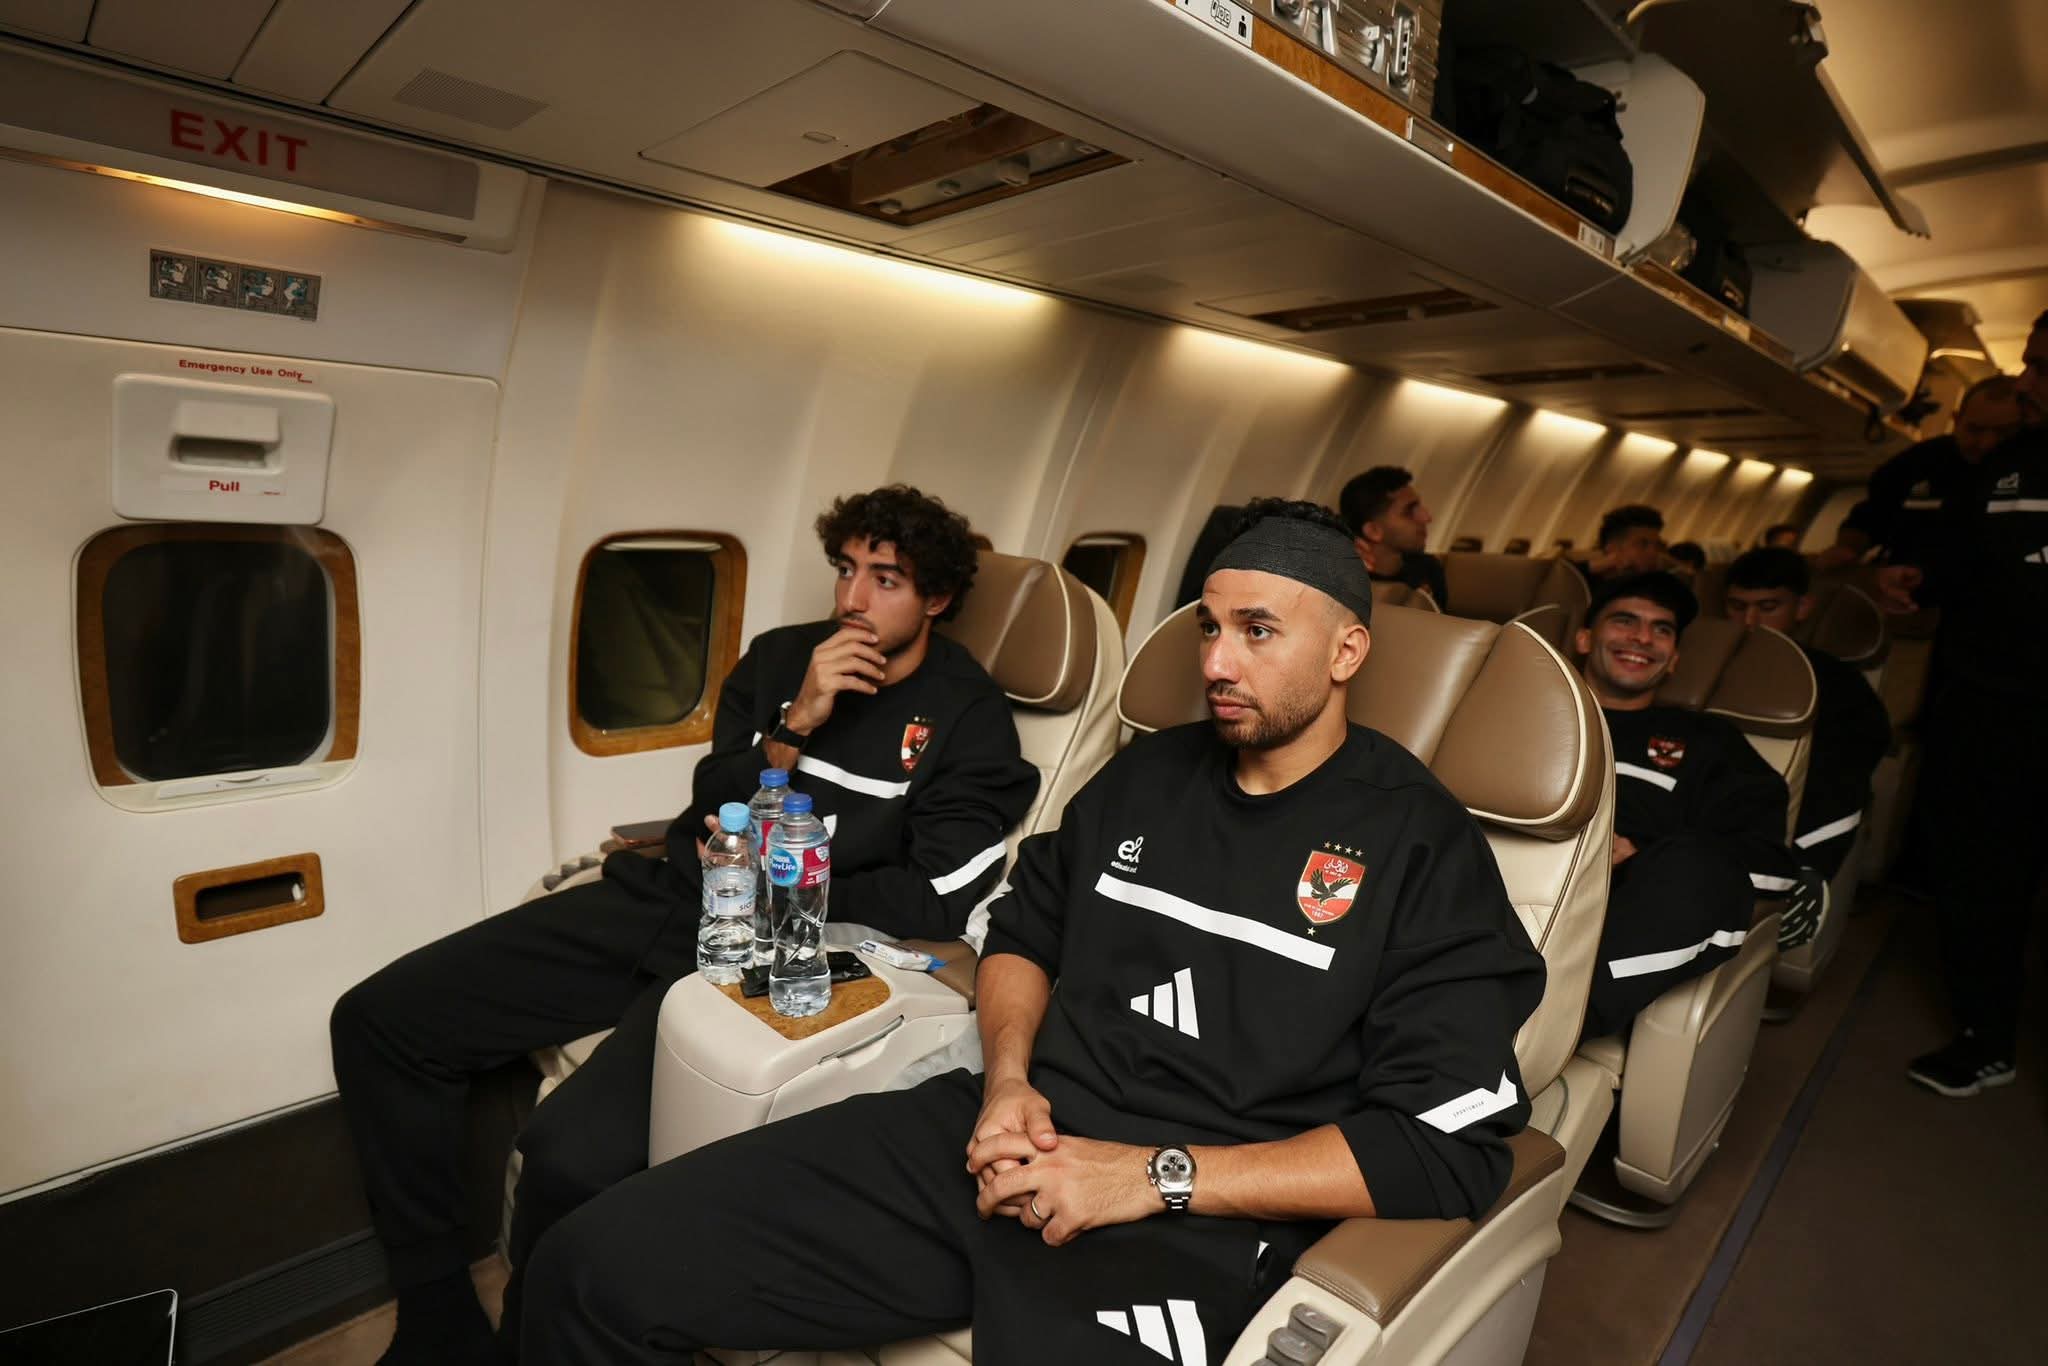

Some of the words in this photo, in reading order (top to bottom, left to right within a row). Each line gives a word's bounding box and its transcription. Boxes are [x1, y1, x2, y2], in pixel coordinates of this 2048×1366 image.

[171, 110, 308, 172] EXIT
[179, 359, 246, 374] Emergency
[251, 366, 273, 376] Use
[278, 368, 304, 381] Only
[209, 480, 240, 492] Pull
